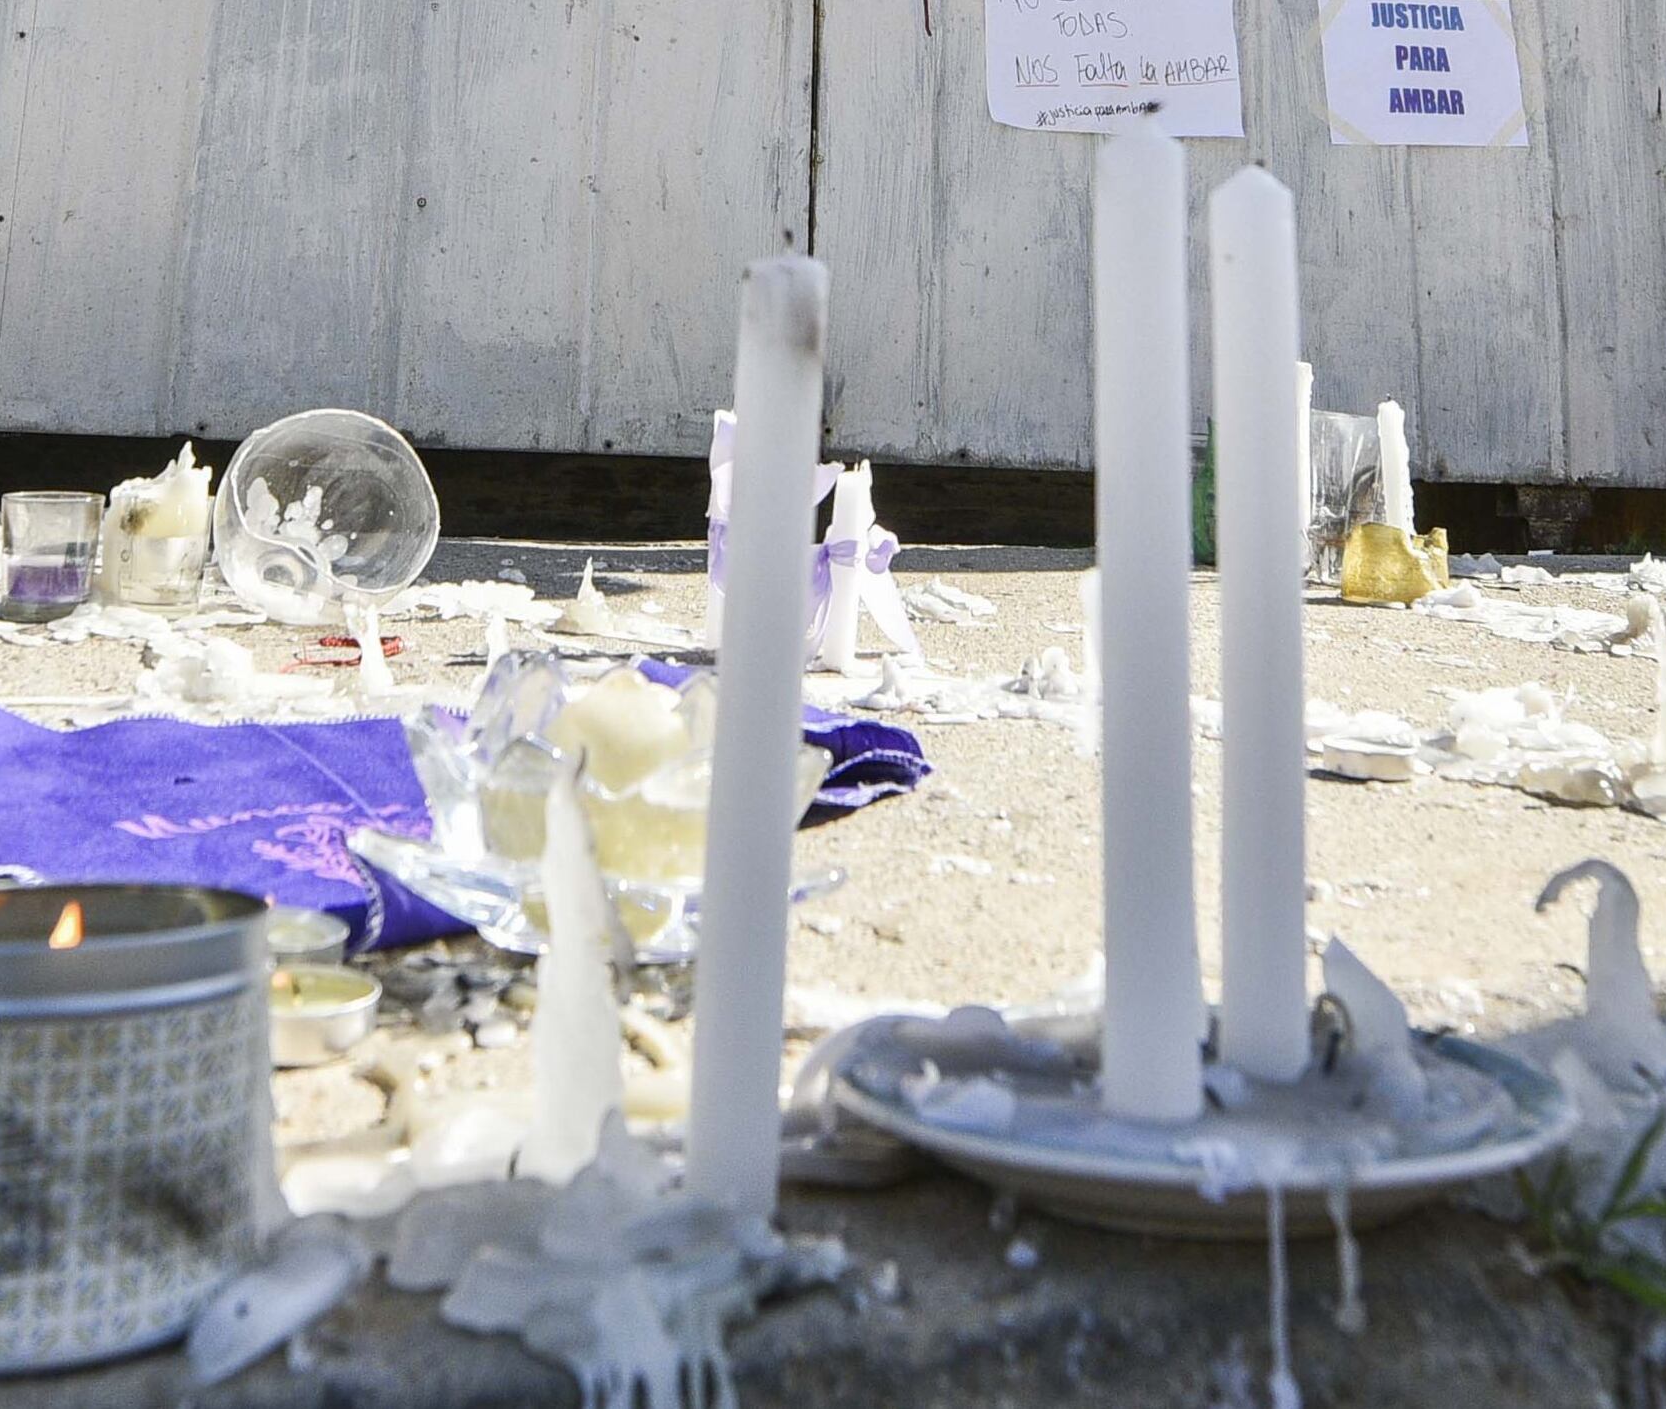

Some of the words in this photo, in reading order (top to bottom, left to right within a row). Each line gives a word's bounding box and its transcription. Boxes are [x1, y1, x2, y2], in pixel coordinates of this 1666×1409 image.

[1371, 2, 1464, 31] JUSTICIA
[1015, 56, 1058, 84] NOS
[1165, 55, 1230, 86] AMBAR
[1395, 45, 1451, 72] PARA
[1389, 88, 1465, 115] AMBAR
